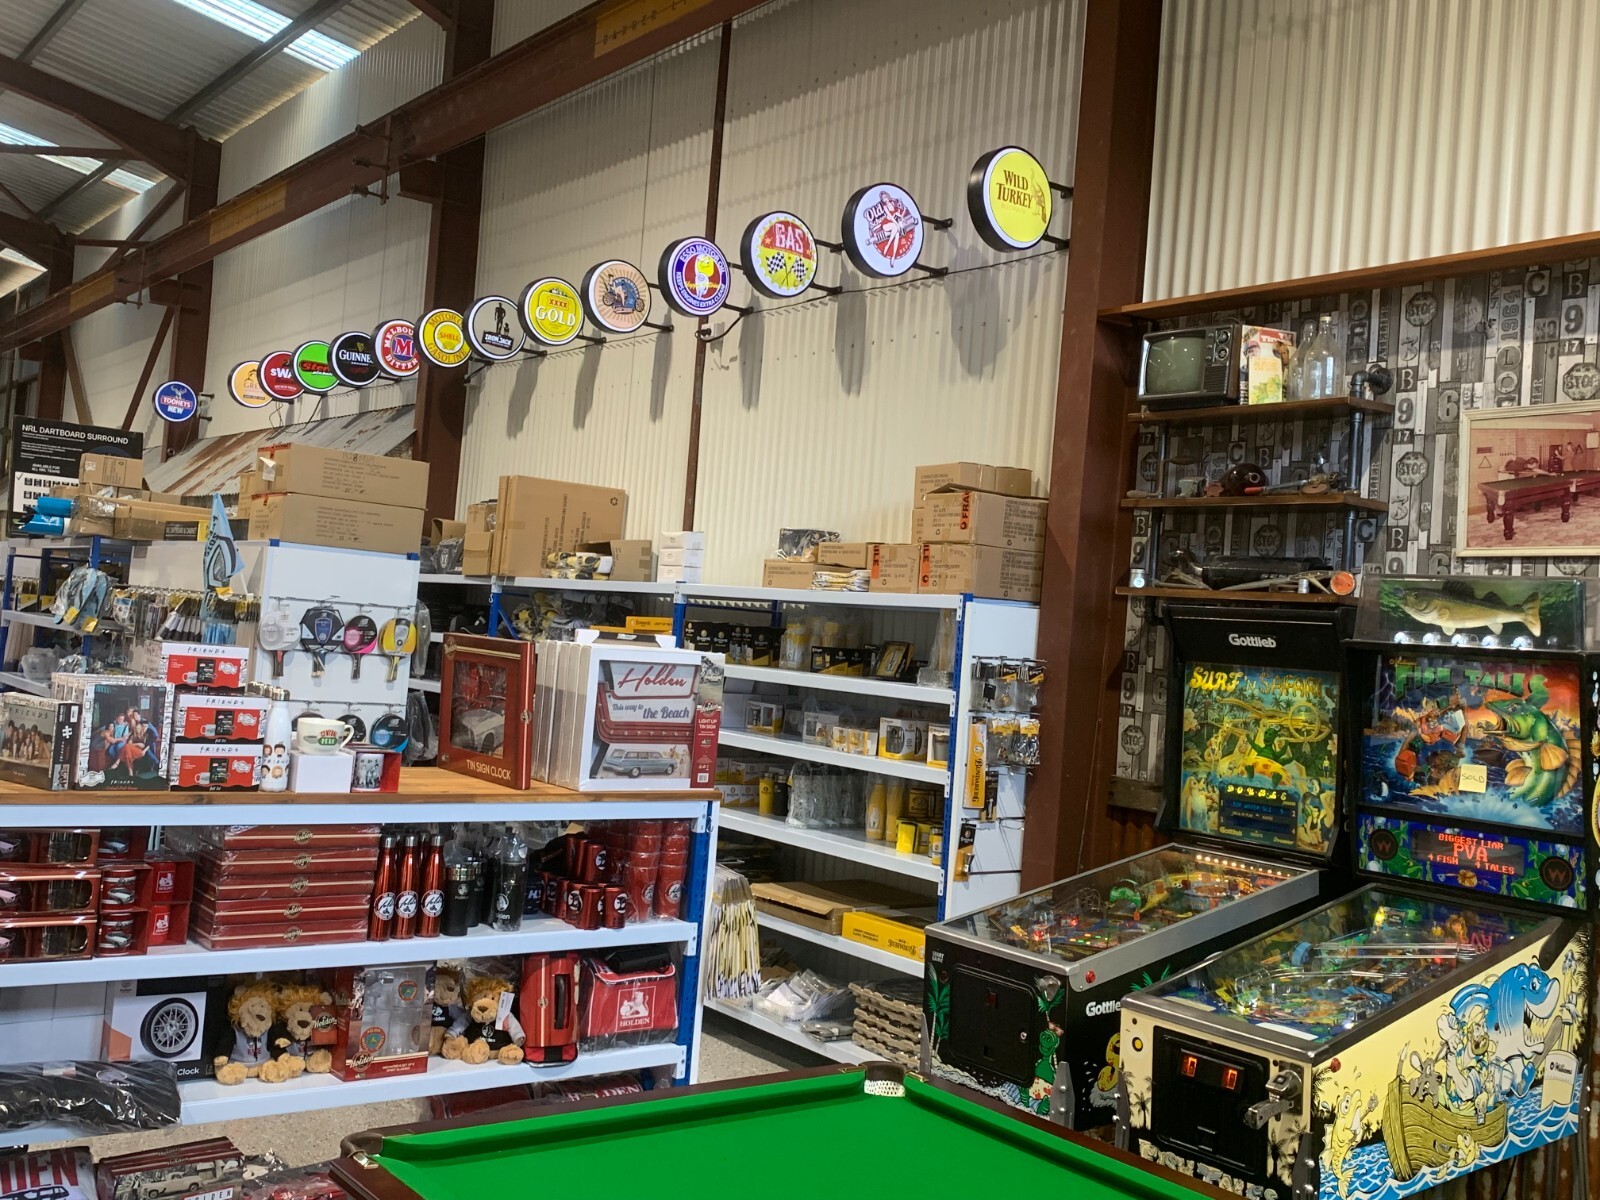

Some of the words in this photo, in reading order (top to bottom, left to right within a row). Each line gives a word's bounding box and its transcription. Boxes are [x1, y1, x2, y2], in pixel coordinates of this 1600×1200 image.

[1003, 169, 1029, 191] WILD
[996, 182, 1034, 209] TURKEY
[864, 202, 885, 221] Old
[774, 222, 804, 254] GAS
[680, 246, 696, 263] ESSO
[696, 245, 719, 261] MOTOR
[1527, 272, 1546, 296] C
[1567, 273, 1583, 296] B
[548, 298, 567, 309] XXXX
[699, 300, 715, 308] EXTRA
[1408, 302, 1436, 317] STOP
[535, 306, 576, 327] GOLD
[1501, 289, 1520, 341] 1964
[1564, 304, 1584, 334] 9
[384, 326, 414, 348] MELBOU
[440, 331, 459, 341] SHELL
[484, 333, 499, 342] IRON
[393, 338, 413, 357] M
[427, 342, 468, 365] GASOLINE
[1564, 340, 1580, 353] 17
[339, 349, 374, 364] GUINNE
[385, 354, 419, 370] BITTER
[1401, 368, 1414, 390] B
[163, 397, 191, 408] TOOHEYS
[167, 405, 184, 414] NEW
[1397, 397, 1415, 425] 9
[1438, 389, 1459, 422] 6
[21, 424, 38, 433] NRL
[39, 426, 86, 439] DARTBOARD
[86, 433, 129, 445] SURROUND
[1398, 430, 1411, 442] 17
[1229, 443, 1244, 463] C
[1259, 447, 1270, 467] B
[1399, 463, 1427, 476] STOP
[1136, 516, 1146, 535] B
[1357, 520, 1374, 541] C
[1391, 528, 1404, 549] B
[1132, 540, 1146, 564] 9
[1228, 633, 1277, 648] Gottlieb
[187, 647, 226, 655] FRIENDS
[617, 663, 687, 692] Holden
[1189, 666, 1244, 692] SURF
[1258, 672, 1322, 698] SAFARI
[1394, 664, 1450, 699] FISH
[1464, 668, 1549, 707] TALES
[1123, 677, 1136, 701] 9
[8, 707, 49, 720] FRIENDS
[624, 704, 637, 712] way
[642, 708, 658, 719] the
[660, 706, 690, 719] Beach
[1122, 705, 1132, 716] 17
[466, 759, 476, 771] TIN
[476, 761, 490, 775] SIGN
[490, 766, 511, 781] CLOCK
[1461, 772, 1485, 784] SOLD
[1376, 840, 1392, 851] W
[1438, 833, 1479, 846] BIGGEST
[1480, 839, 1504, 850] LIAR
[1453, 842, 1488, 862] PVA
[1428, 853, 1434, 861] 4
[1436, 855, 1459, 865] FISH
[1474, 861, 1481, 869] 4
[1484, 863, 1515, 875] TALES
[1550, 869, 1567, 882] W
[932, 950, 945, 958] START
[1085, 1000, 1121, 1017] Gottlie
[314, 1014, 338, 1028] Holden
[619, 1017, 651, 1027] HOLDEN
[350, 1054, 374, 1068] Holden
[1555, 1061, 1573, 1075] Williams
[177, 1066, 200, 1076] Clock
[566, 1085, 641, 1102] HLDEN
[167, 1156, 189, 1165] Holden
